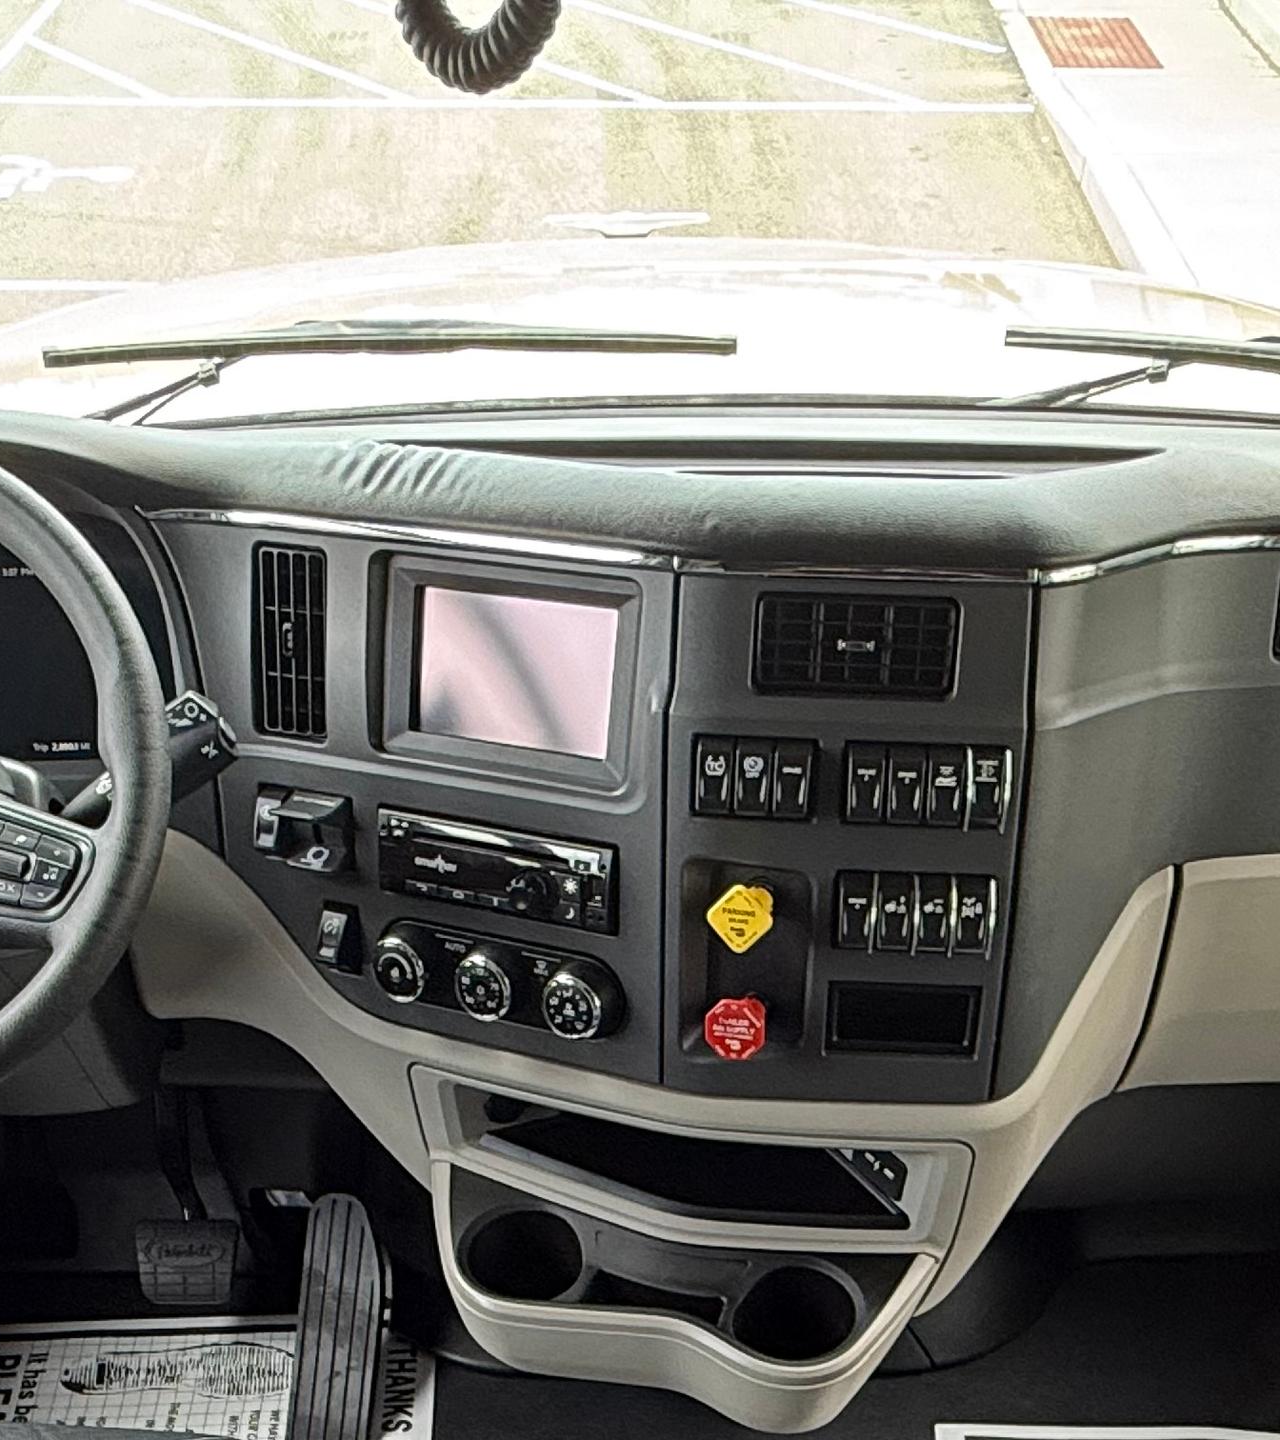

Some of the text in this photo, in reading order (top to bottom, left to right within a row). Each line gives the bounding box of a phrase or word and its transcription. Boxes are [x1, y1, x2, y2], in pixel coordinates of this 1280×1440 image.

[12, 1352, 50, 1424] It has be
[380, 1349, 418, 1434] THANKS
